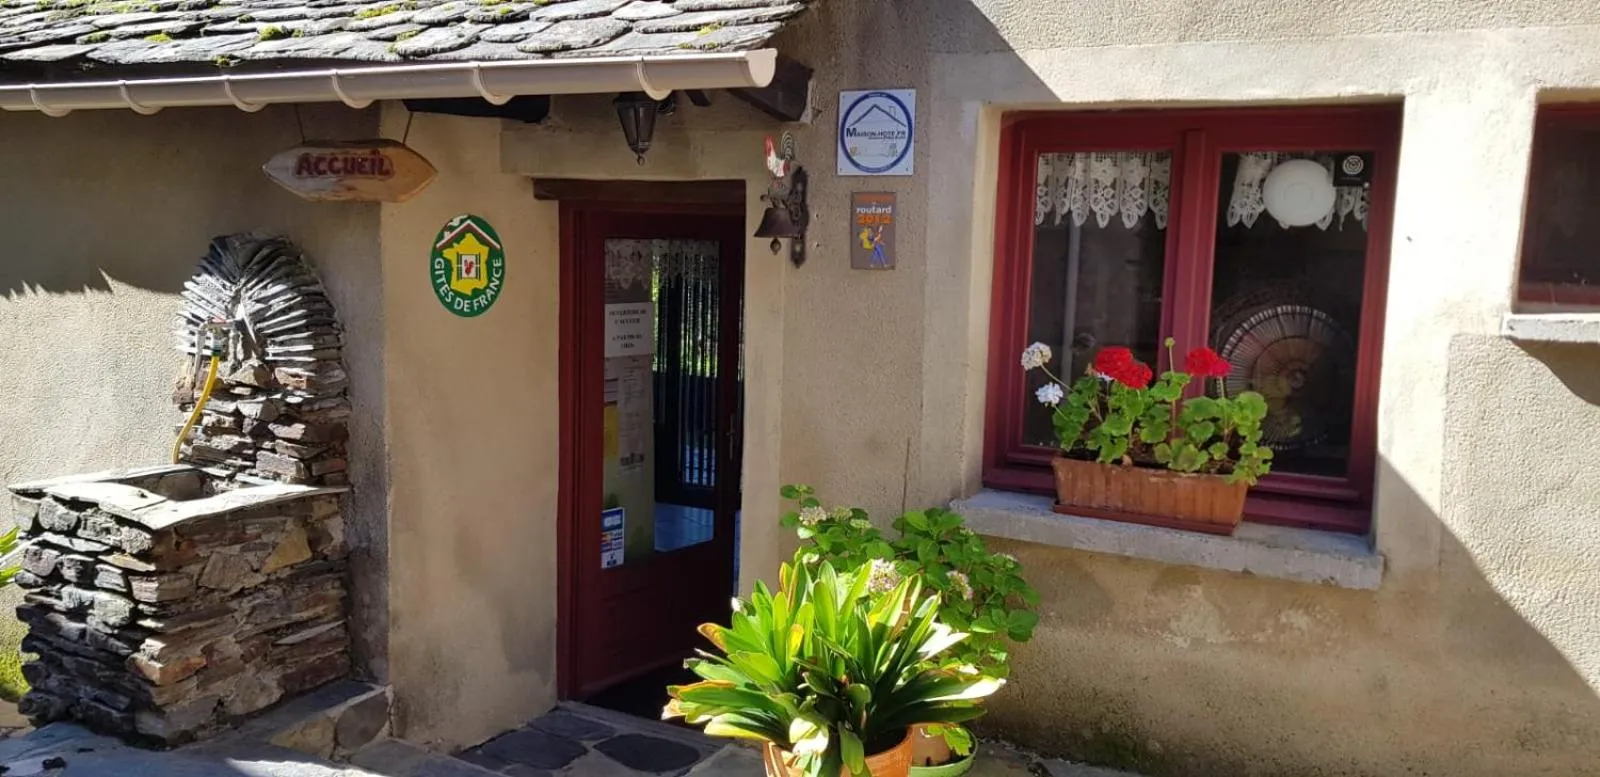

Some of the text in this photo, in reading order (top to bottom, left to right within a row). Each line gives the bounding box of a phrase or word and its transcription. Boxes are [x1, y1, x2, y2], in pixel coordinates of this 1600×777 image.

[296, 151, 390, 177] ACCUEIL
[856, 205, 893, 214] routard
[434, 257, 502, 312] GITES DE FRANCE
